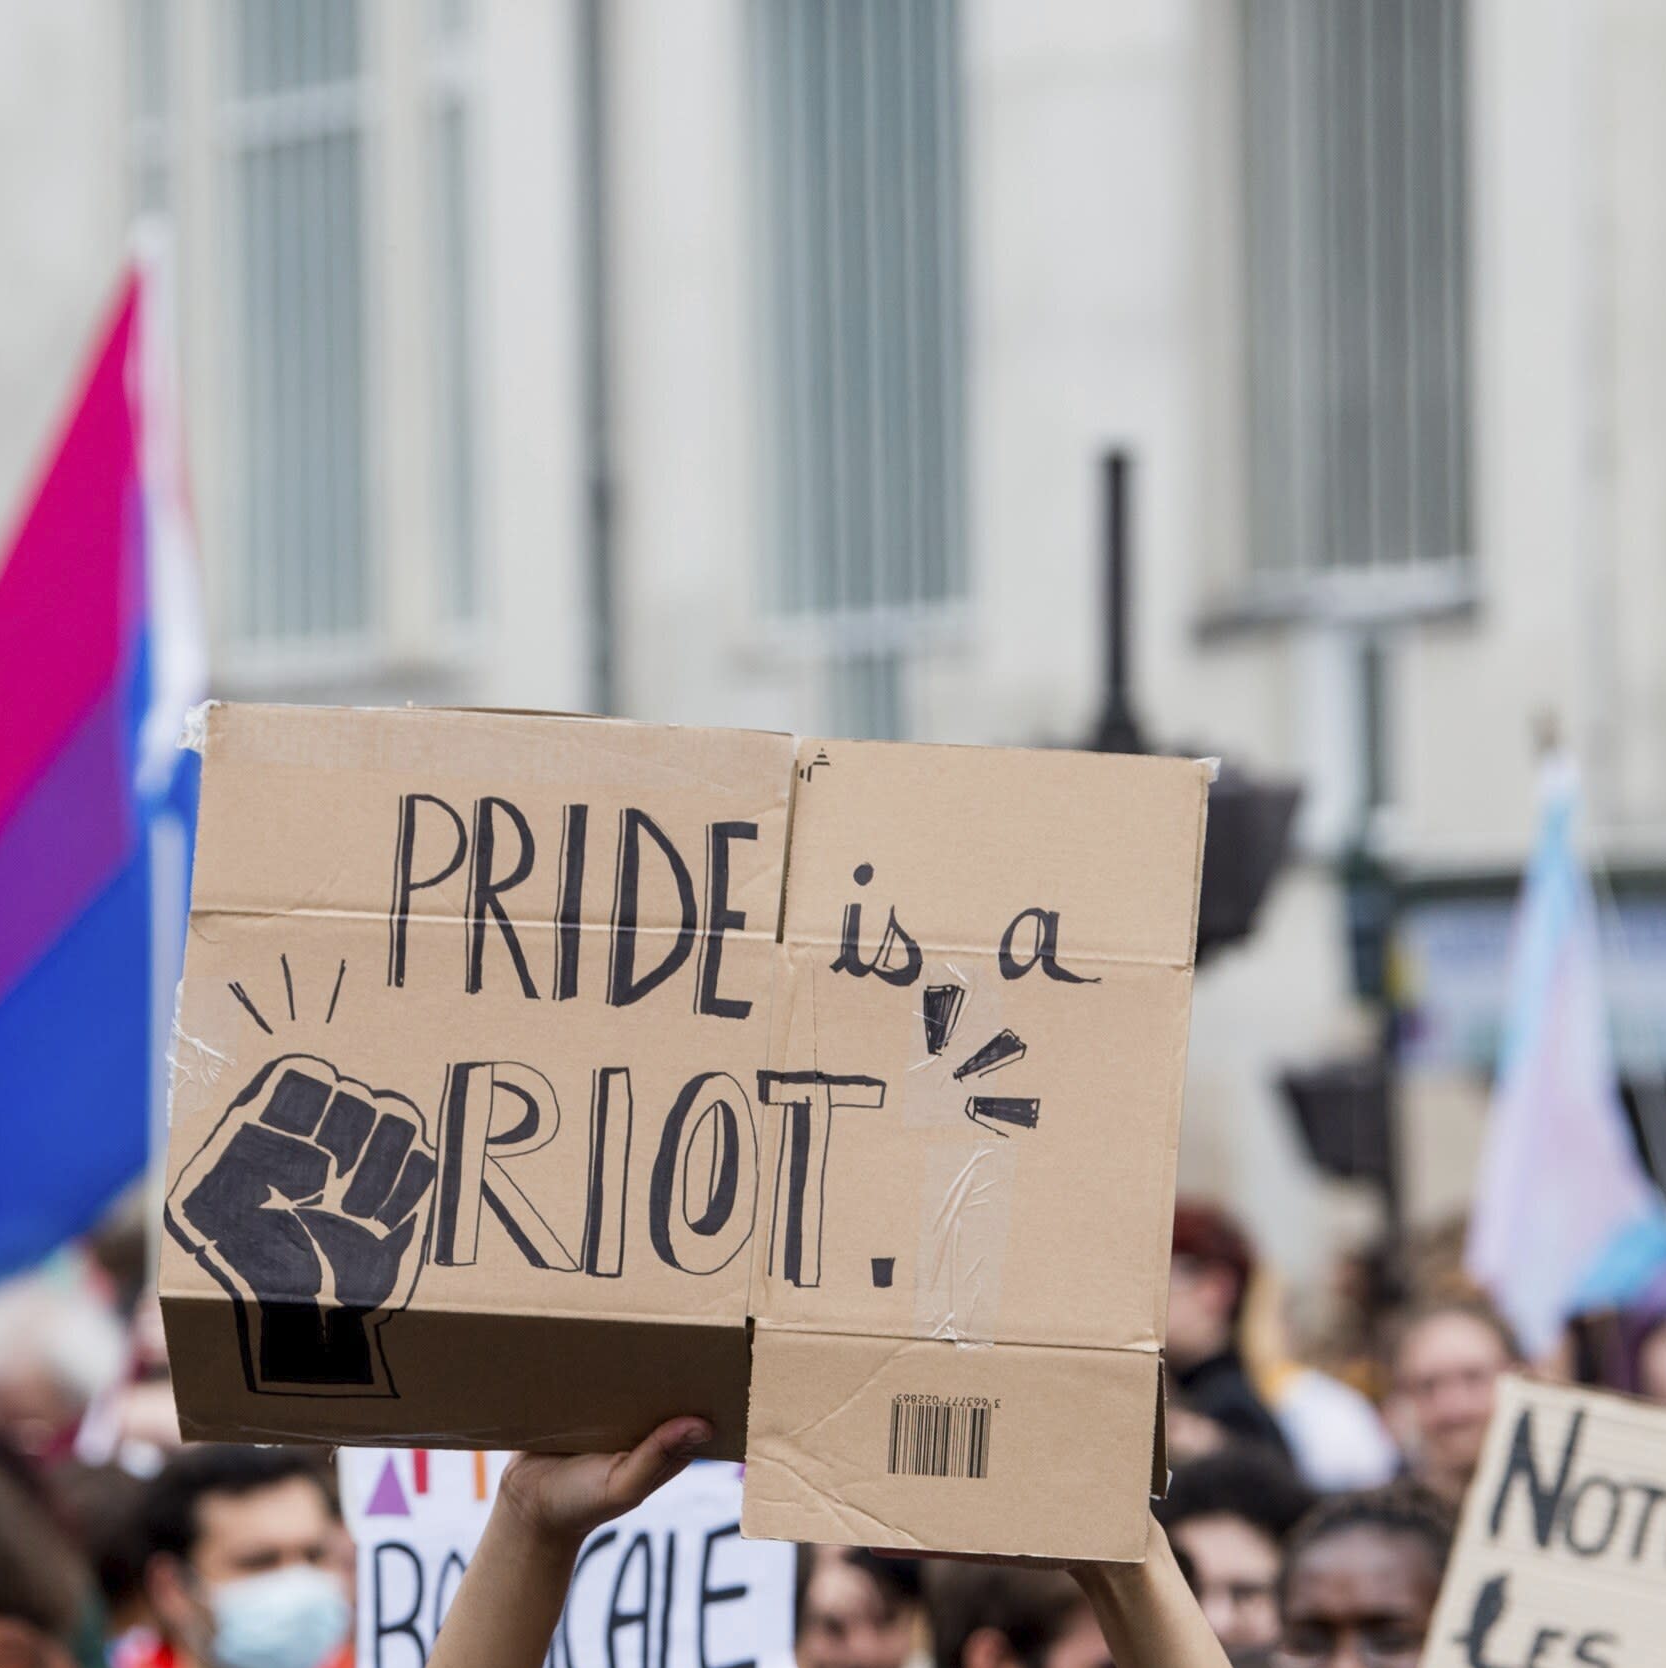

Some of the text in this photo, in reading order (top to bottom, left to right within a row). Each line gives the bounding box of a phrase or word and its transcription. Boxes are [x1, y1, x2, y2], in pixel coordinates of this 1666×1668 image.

[388, 793, 1102, 1020] PRIDE is a
[423, 1060, 895, 1289] RIOT.
[895, 1393, 1002, 1409] 3 663777 022865
